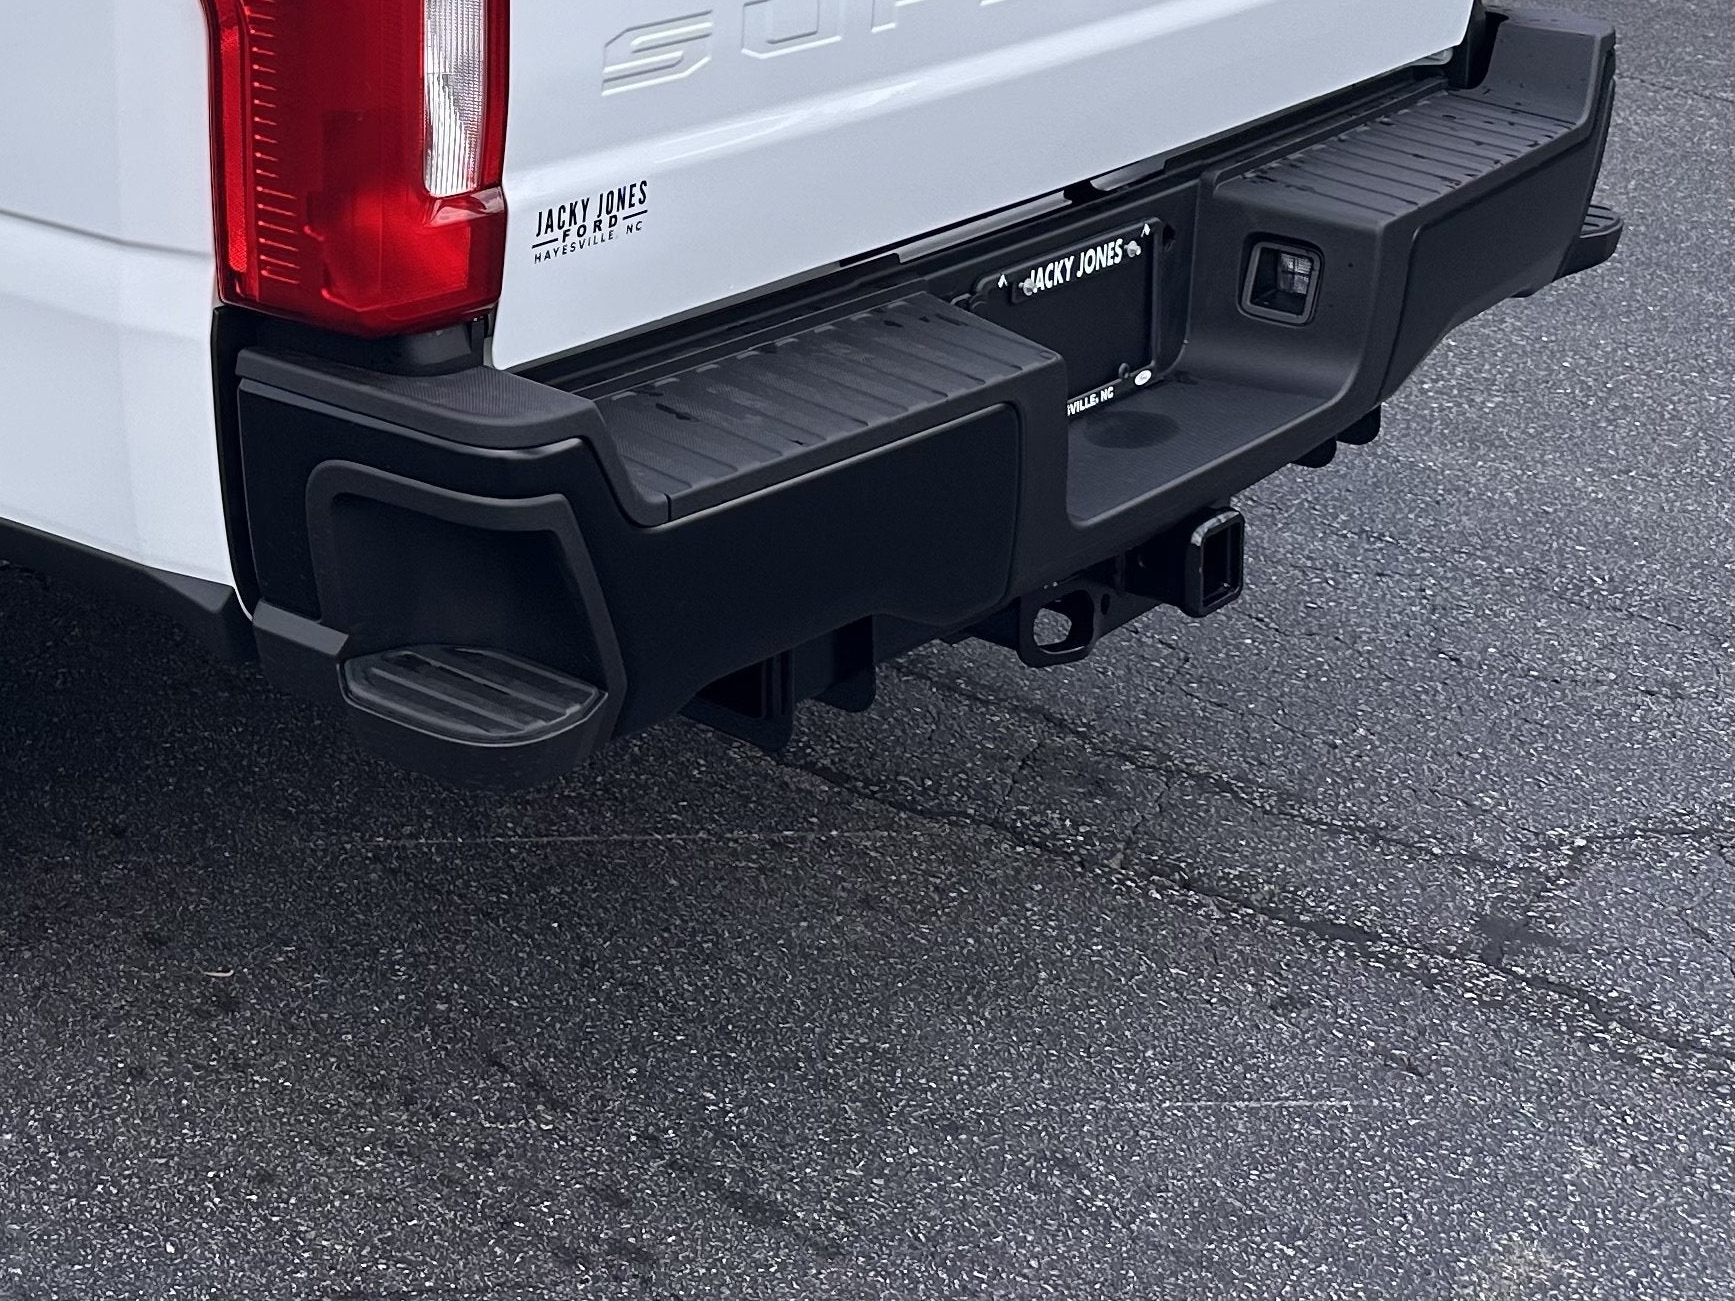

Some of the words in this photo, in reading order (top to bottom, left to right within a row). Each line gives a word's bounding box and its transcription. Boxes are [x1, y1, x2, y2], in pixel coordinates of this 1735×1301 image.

[535, 197, 590, 237] JACKY
[597, 179, 648, 218] JONES
[562, 214, 618, 243] FORD
[625, 220, 643, 235] NC
[1028, 255, 1075, 292] JACKY
[1076, 238, 1124, 278] JONES
[1100, 386, 1114, 402] NC
